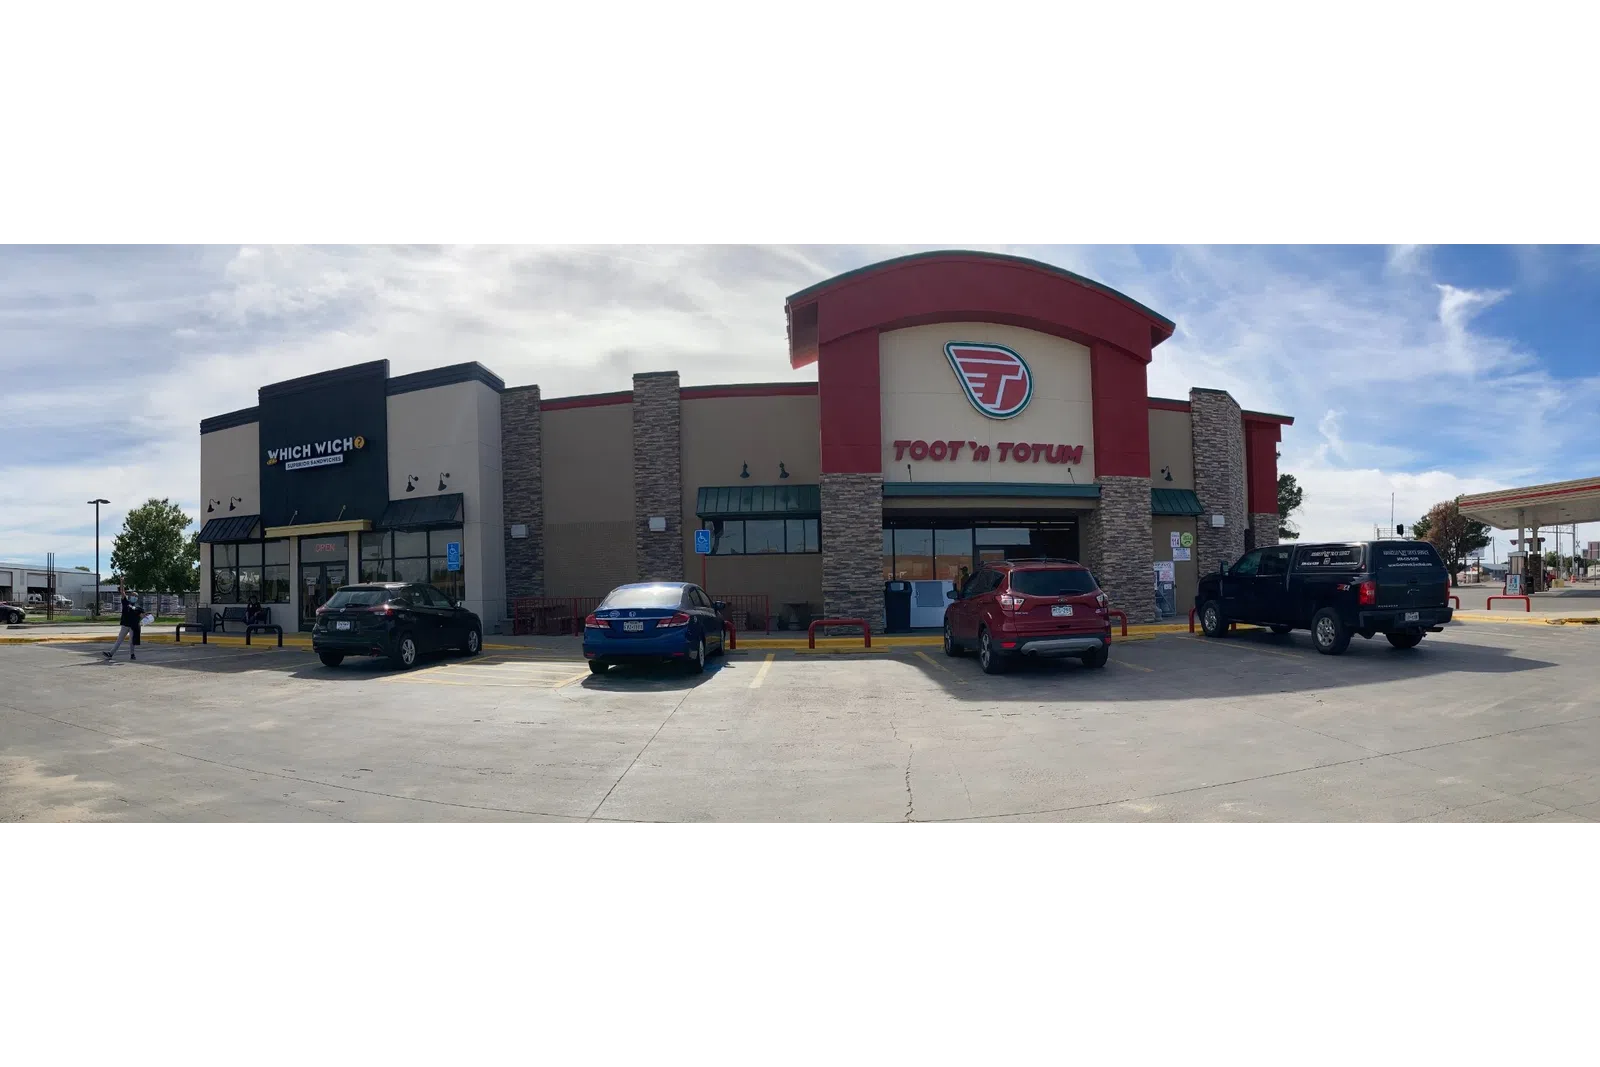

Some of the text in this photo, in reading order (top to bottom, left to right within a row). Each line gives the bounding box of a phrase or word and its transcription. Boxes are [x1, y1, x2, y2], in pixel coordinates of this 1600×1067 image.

[267, 444, 311, 461] WHICH
[893, 440, 965, 461] TOOT
[997, 442, 1084, 465] TOTUM
[287, 456, 342, 469] SUPERIOR SANDWICHES
[315, 543, 336, 552] OPEN
